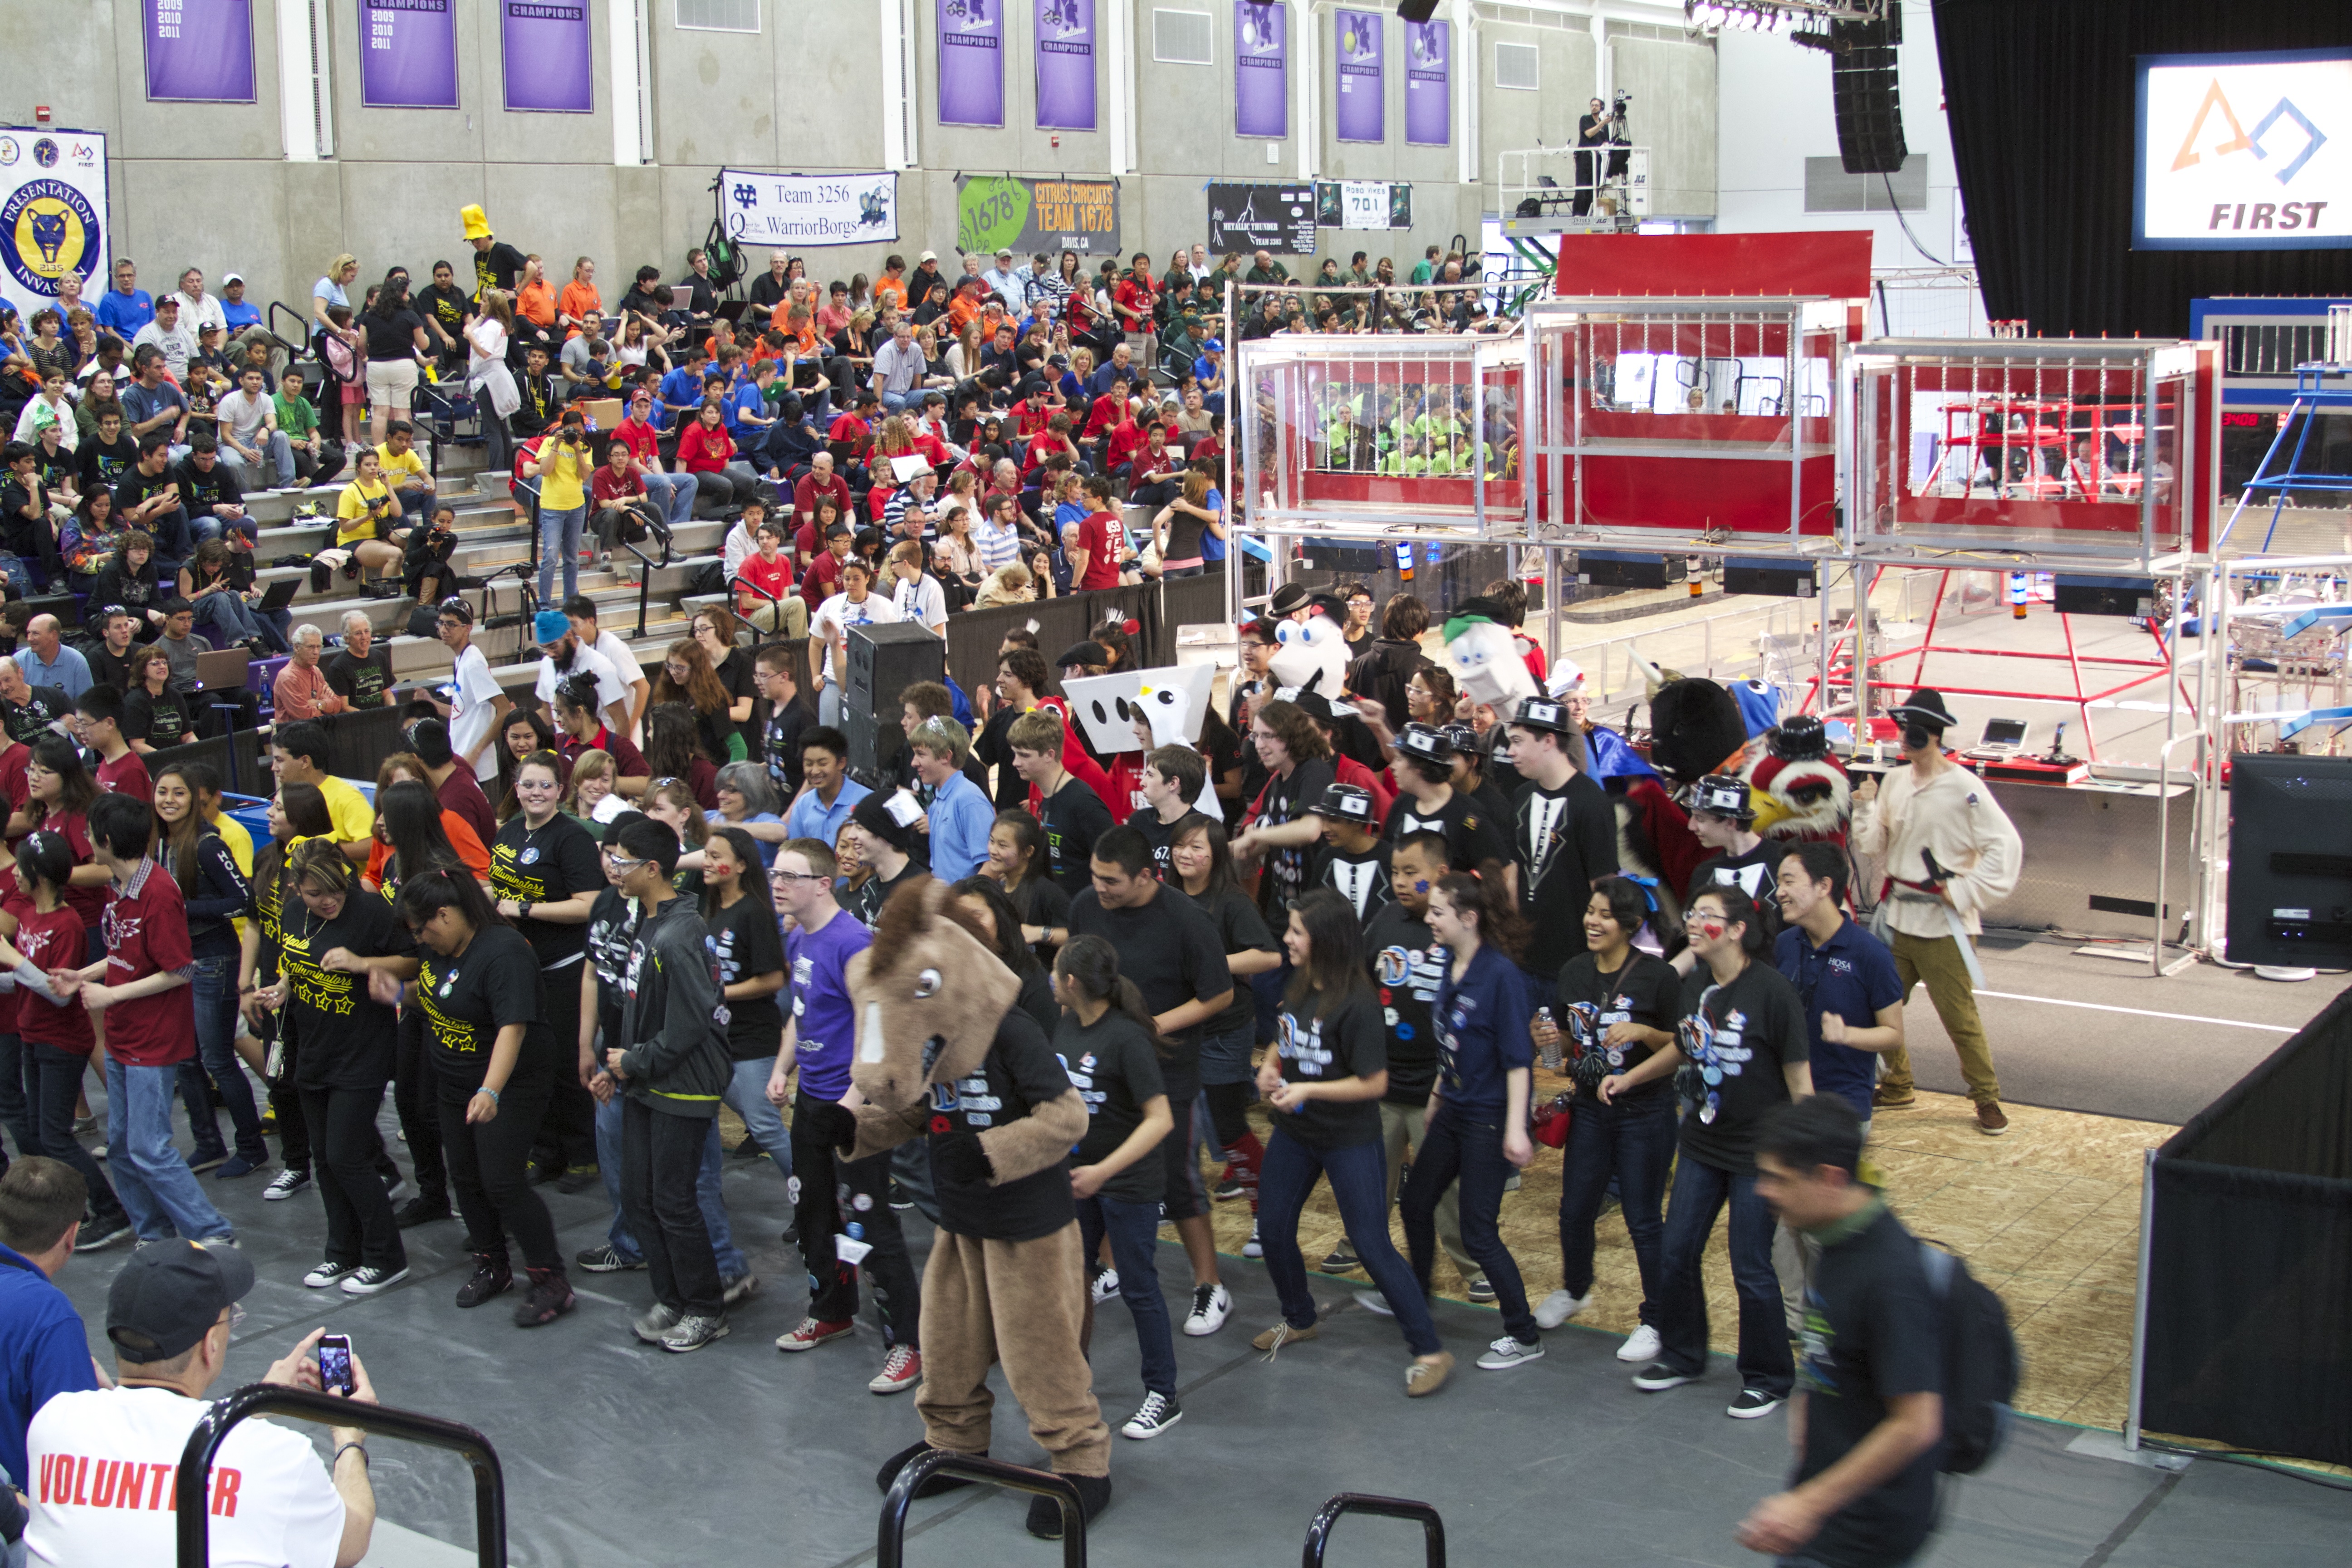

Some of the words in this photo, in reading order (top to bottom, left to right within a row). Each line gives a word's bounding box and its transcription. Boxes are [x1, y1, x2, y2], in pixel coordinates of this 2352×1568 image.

[157, 0, 183, 10] 2009
[370, 0, 445, 10] CHAMPIONS
[157, 12, 181, 24] 2010
[372, 10, 395, 22] 2009
[512, 5, 580, 19] CHAMPIONS
[159, 25, 180, 38] 2011
[372, 24, 393, 36] 2010
[372, 37, 391, 49] 2011
[946, 34, 995, 47] CHAMPIONS
[1044, 42, 1089, 54] CHAMPIONS
[1241, 57, 1281, 68] CHAMPIONS
[1342, 65, 1378, 75] CHAMPIONS
[1411, 71, 1445, 81] CHAMPIONS
[1342, 75, 1352, 84] 2010
[1410, 81, 1420, 89] 2011
[1342, 84, 1352, 93] 2011
[1634, 175, 1646, 183] JLG
[775, 185, 812, 204] Team
[817, 184, 850, 204] 3256
[1034, 182, 1069, 204] CITRUS
[1071, 184, 1113, 204] CIRCUITS
[4, 182, 94, 225] PRESENTATION
[1352, 197, 1378, 211] 701
[968, 191, 1014, 236] 1678
[1035, 204, 1075, 231] TEAM
[1079, 204, 1113, 232] 1678
[2208, 202, 2328, 230] FIRST
[766, 216, 858, 239] WarriorBorgs
[1223, 222, 1250, 231] METALLIC
[1251, 222, 1278, 231] THUNDER
[1062, 236, 1079, 249] DAVIS,
[1080, 237, 1089, 249] CA
[39, 264, 64, 272] 2135
[16, 265, 88, 294] INVASN
[2222, 412, 2259, 426] 3408
[495, 843, 517, 858] Apollo
[491, 865, 544, 893] Illuminators
[282, 932, 310, 951] Apollo
[1828, 957, 1851, 970] HOSA
[290, 962, 353, 986] Illuminators
[421, 960, 436, 988] Apollo
[40, 1453, 242, 1518] VOLUNTR
